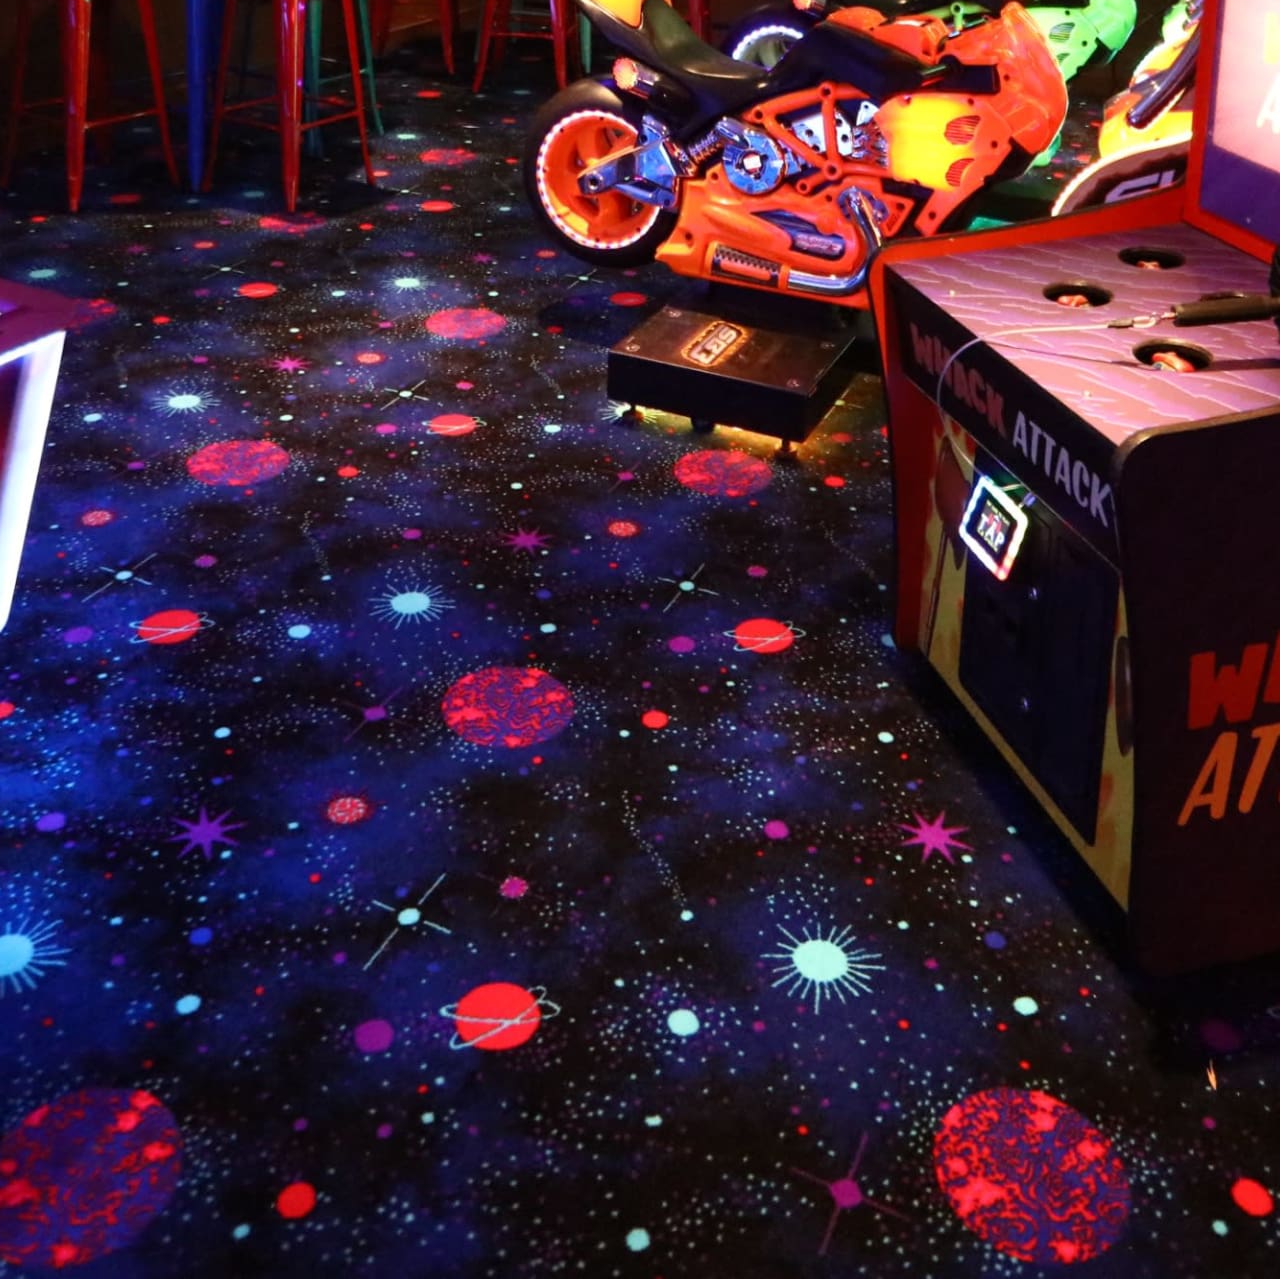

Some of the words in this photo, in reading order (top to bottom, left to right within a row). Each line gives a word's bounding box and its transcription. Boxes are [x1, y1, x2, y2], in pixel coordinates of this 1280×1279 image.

[910, 321, 1007, 438] WHACK
[1013, 410, 1112, 528] ATTACK
[977, 513, 1006, 546] TAP
